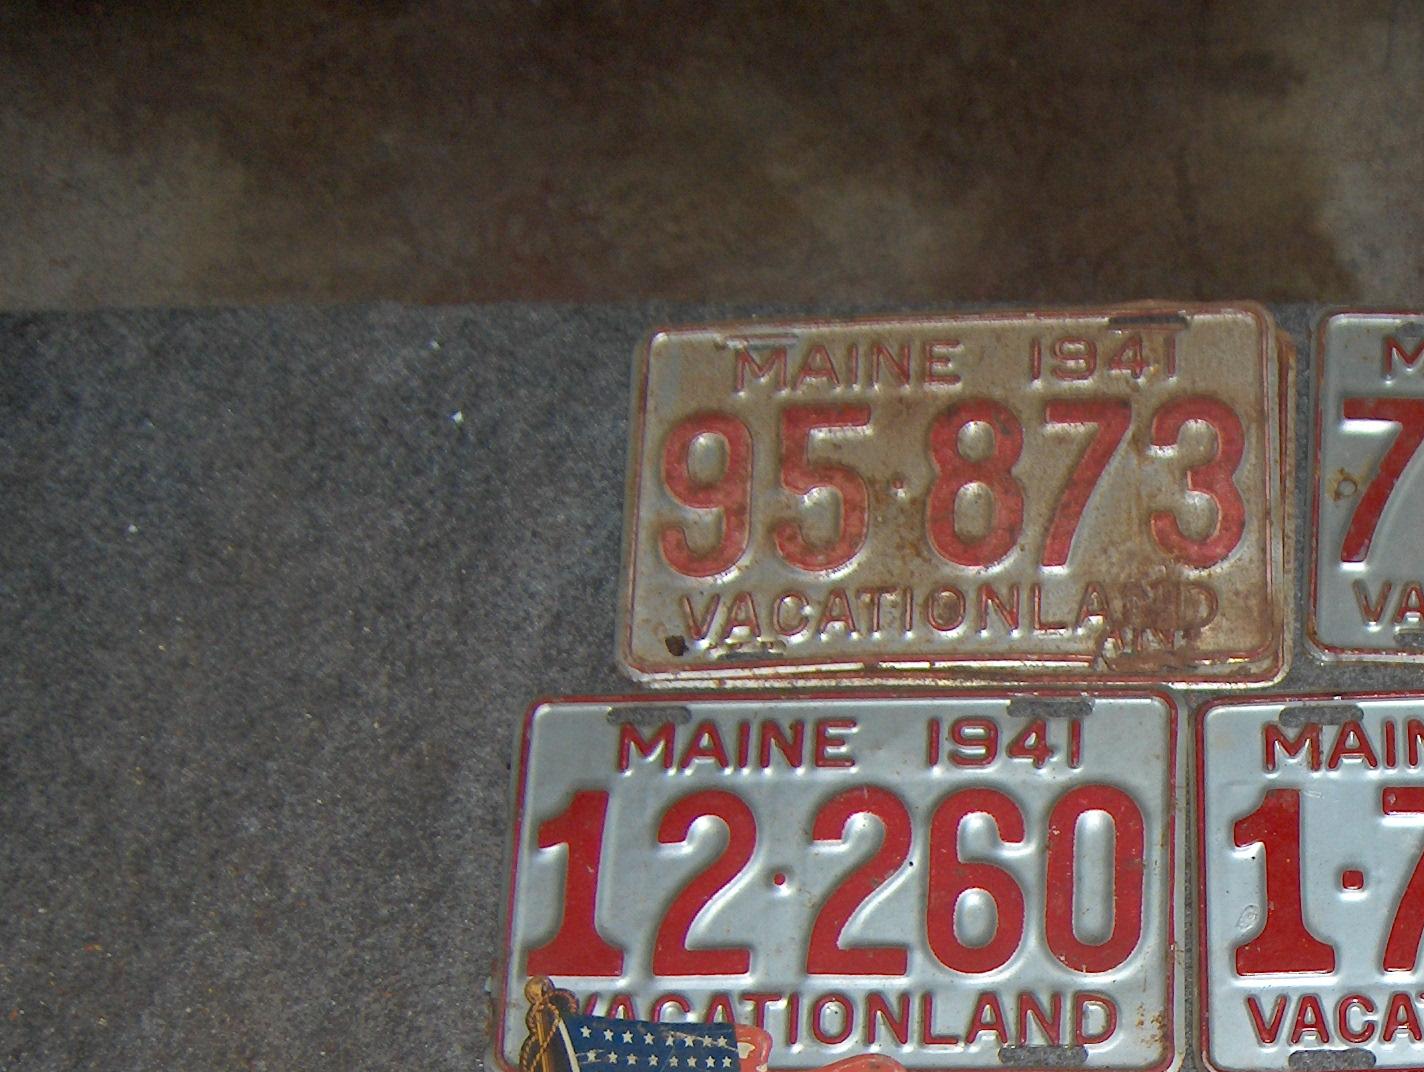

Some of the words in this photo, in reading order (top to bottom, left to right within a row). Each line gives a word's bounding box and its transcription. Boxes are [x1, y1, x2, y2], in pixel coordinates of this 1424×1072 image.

[734, 340, 961, 394] MAINE
[1028, 335, 1180, 383] 1941
[617, 717, 857, 771] MAINE
[928, 716, 1083, 769] 1941
